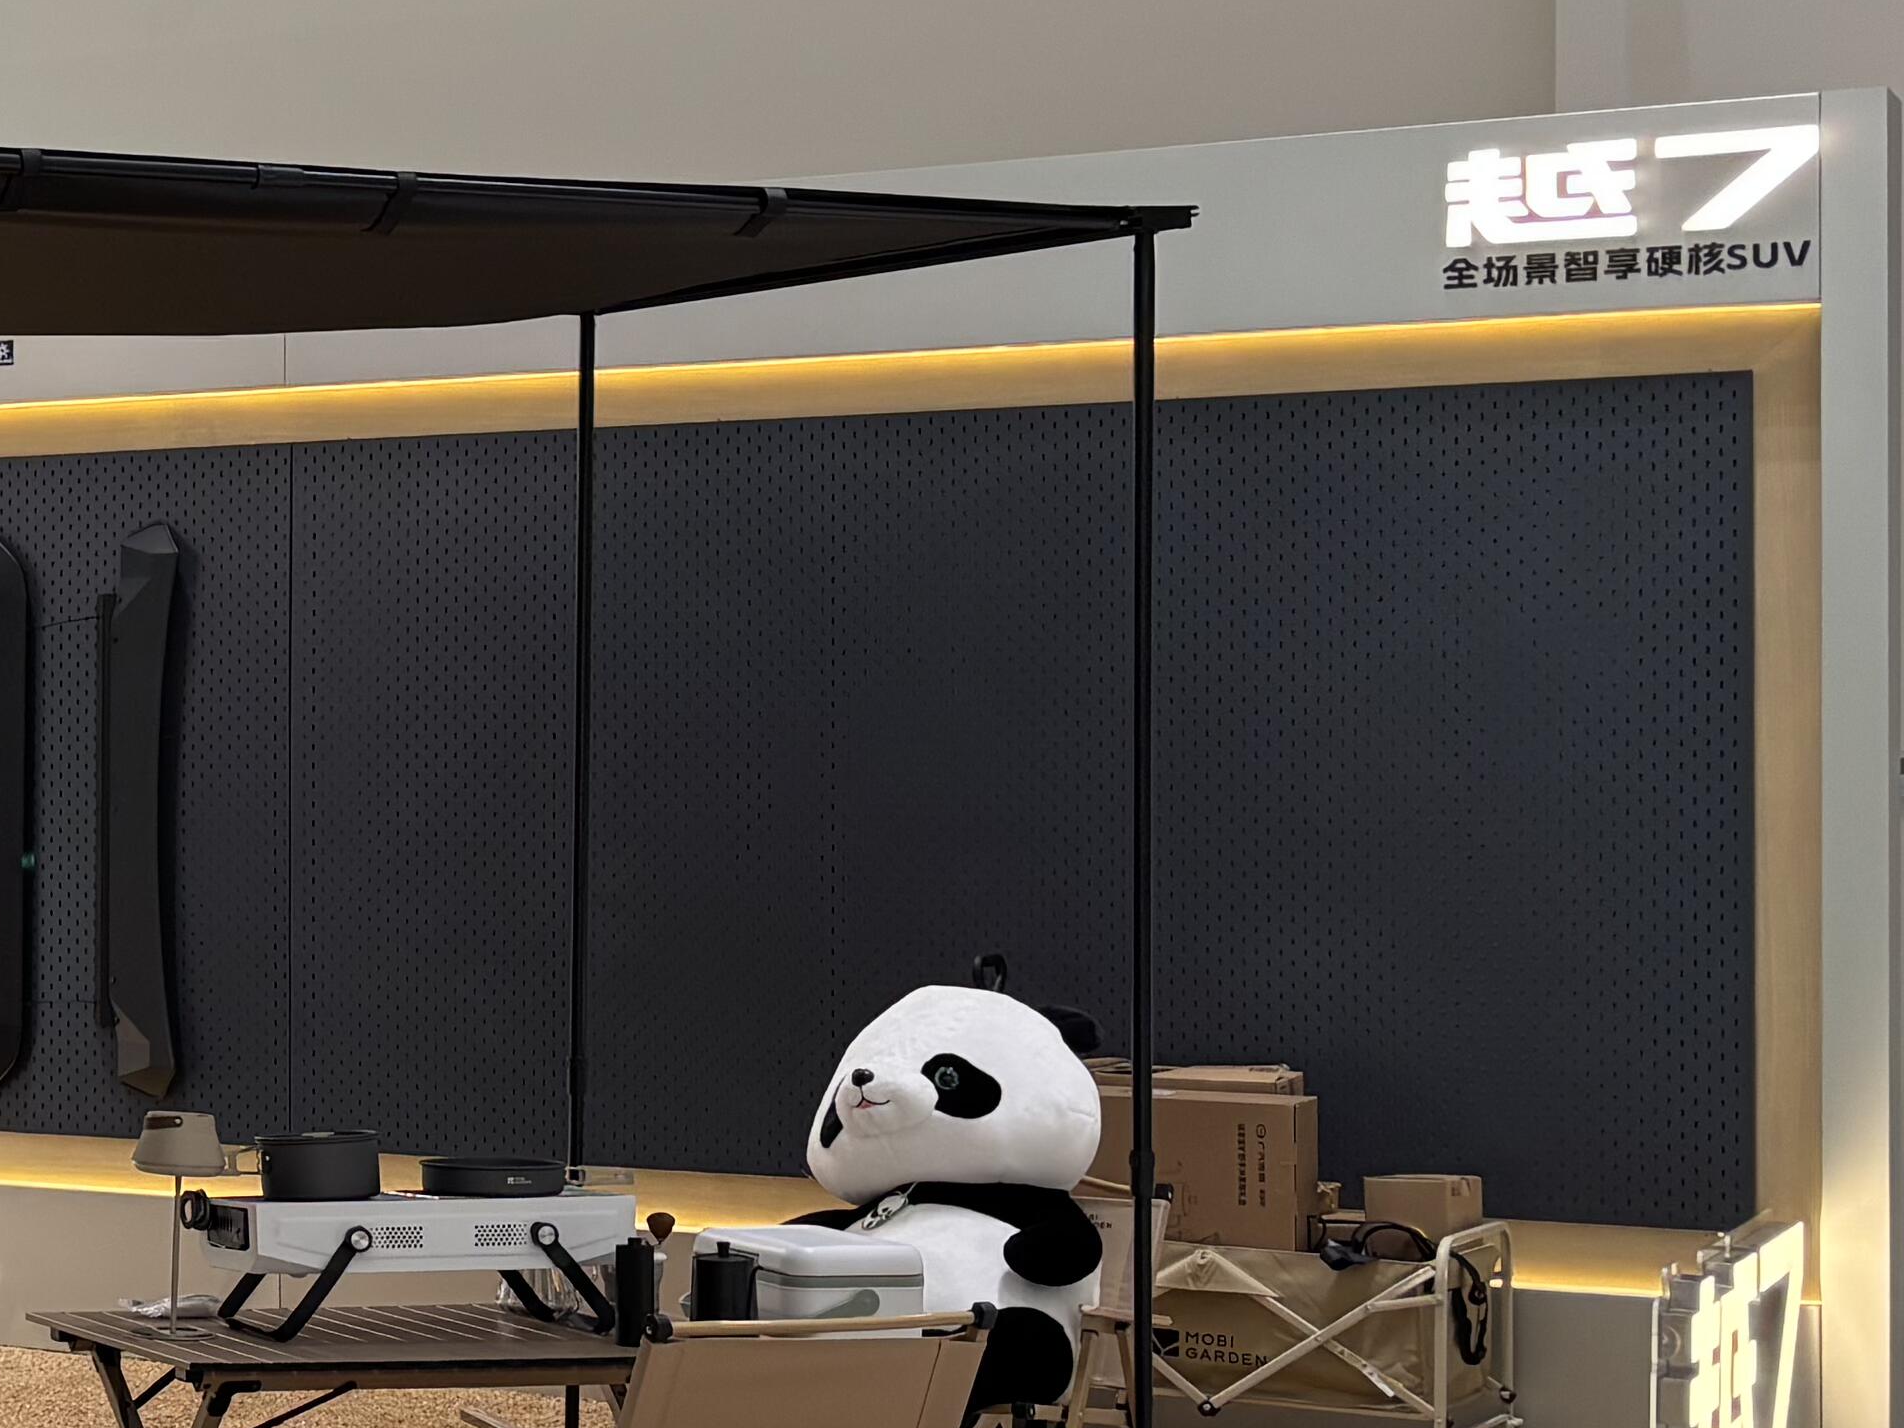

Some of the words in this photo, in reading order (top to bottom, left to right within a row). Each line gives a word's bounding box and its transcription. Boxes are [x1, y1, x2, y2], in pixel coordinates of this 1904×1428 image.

[1444, 124, 1820, 248] 越7
[1442, 239, 1812, 290] 全场景智享硬核SUV
[1185, 1332, 1234, 1349] MOBI
[1185, 1347, 1268, 1366] GARDEN
